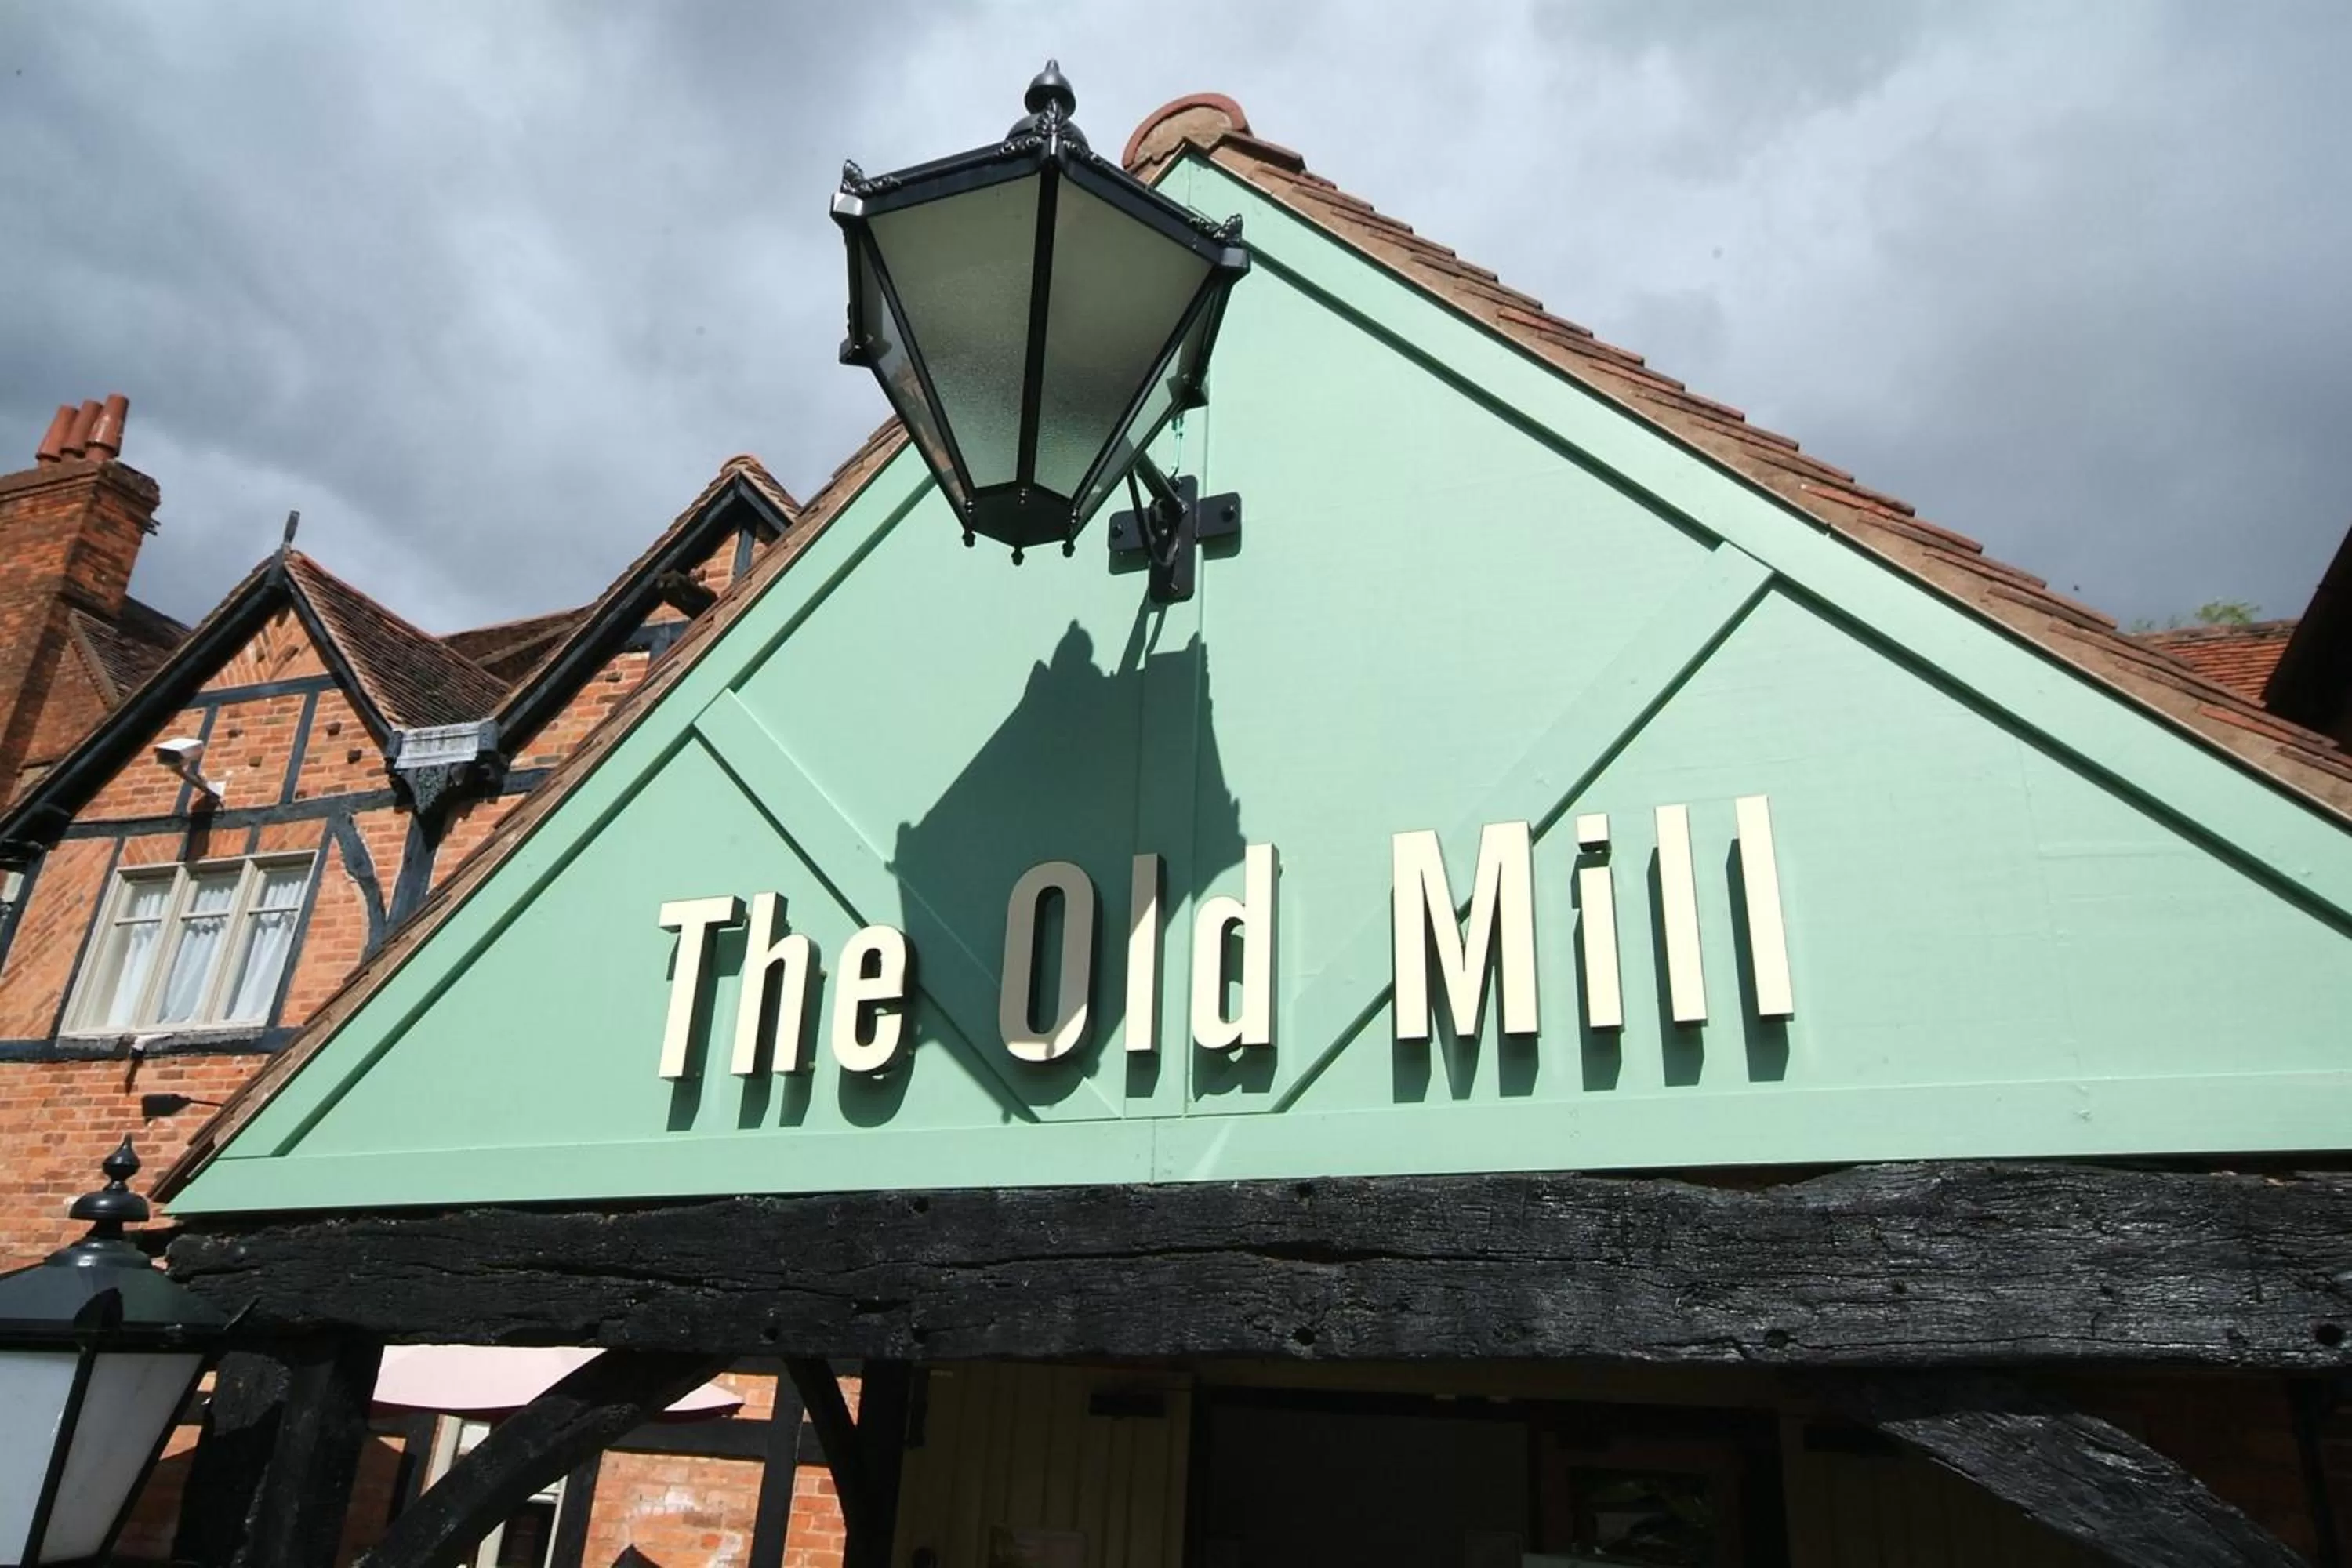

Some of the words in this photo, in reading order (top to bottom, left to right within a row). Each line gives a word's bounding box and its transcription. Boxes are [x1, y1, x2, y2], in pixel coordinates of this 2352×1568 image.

[659, 891, 915, 1080] The
[998, 843, 1279, 1062] Old
[1392, 795, 1795, 1040] Mill
